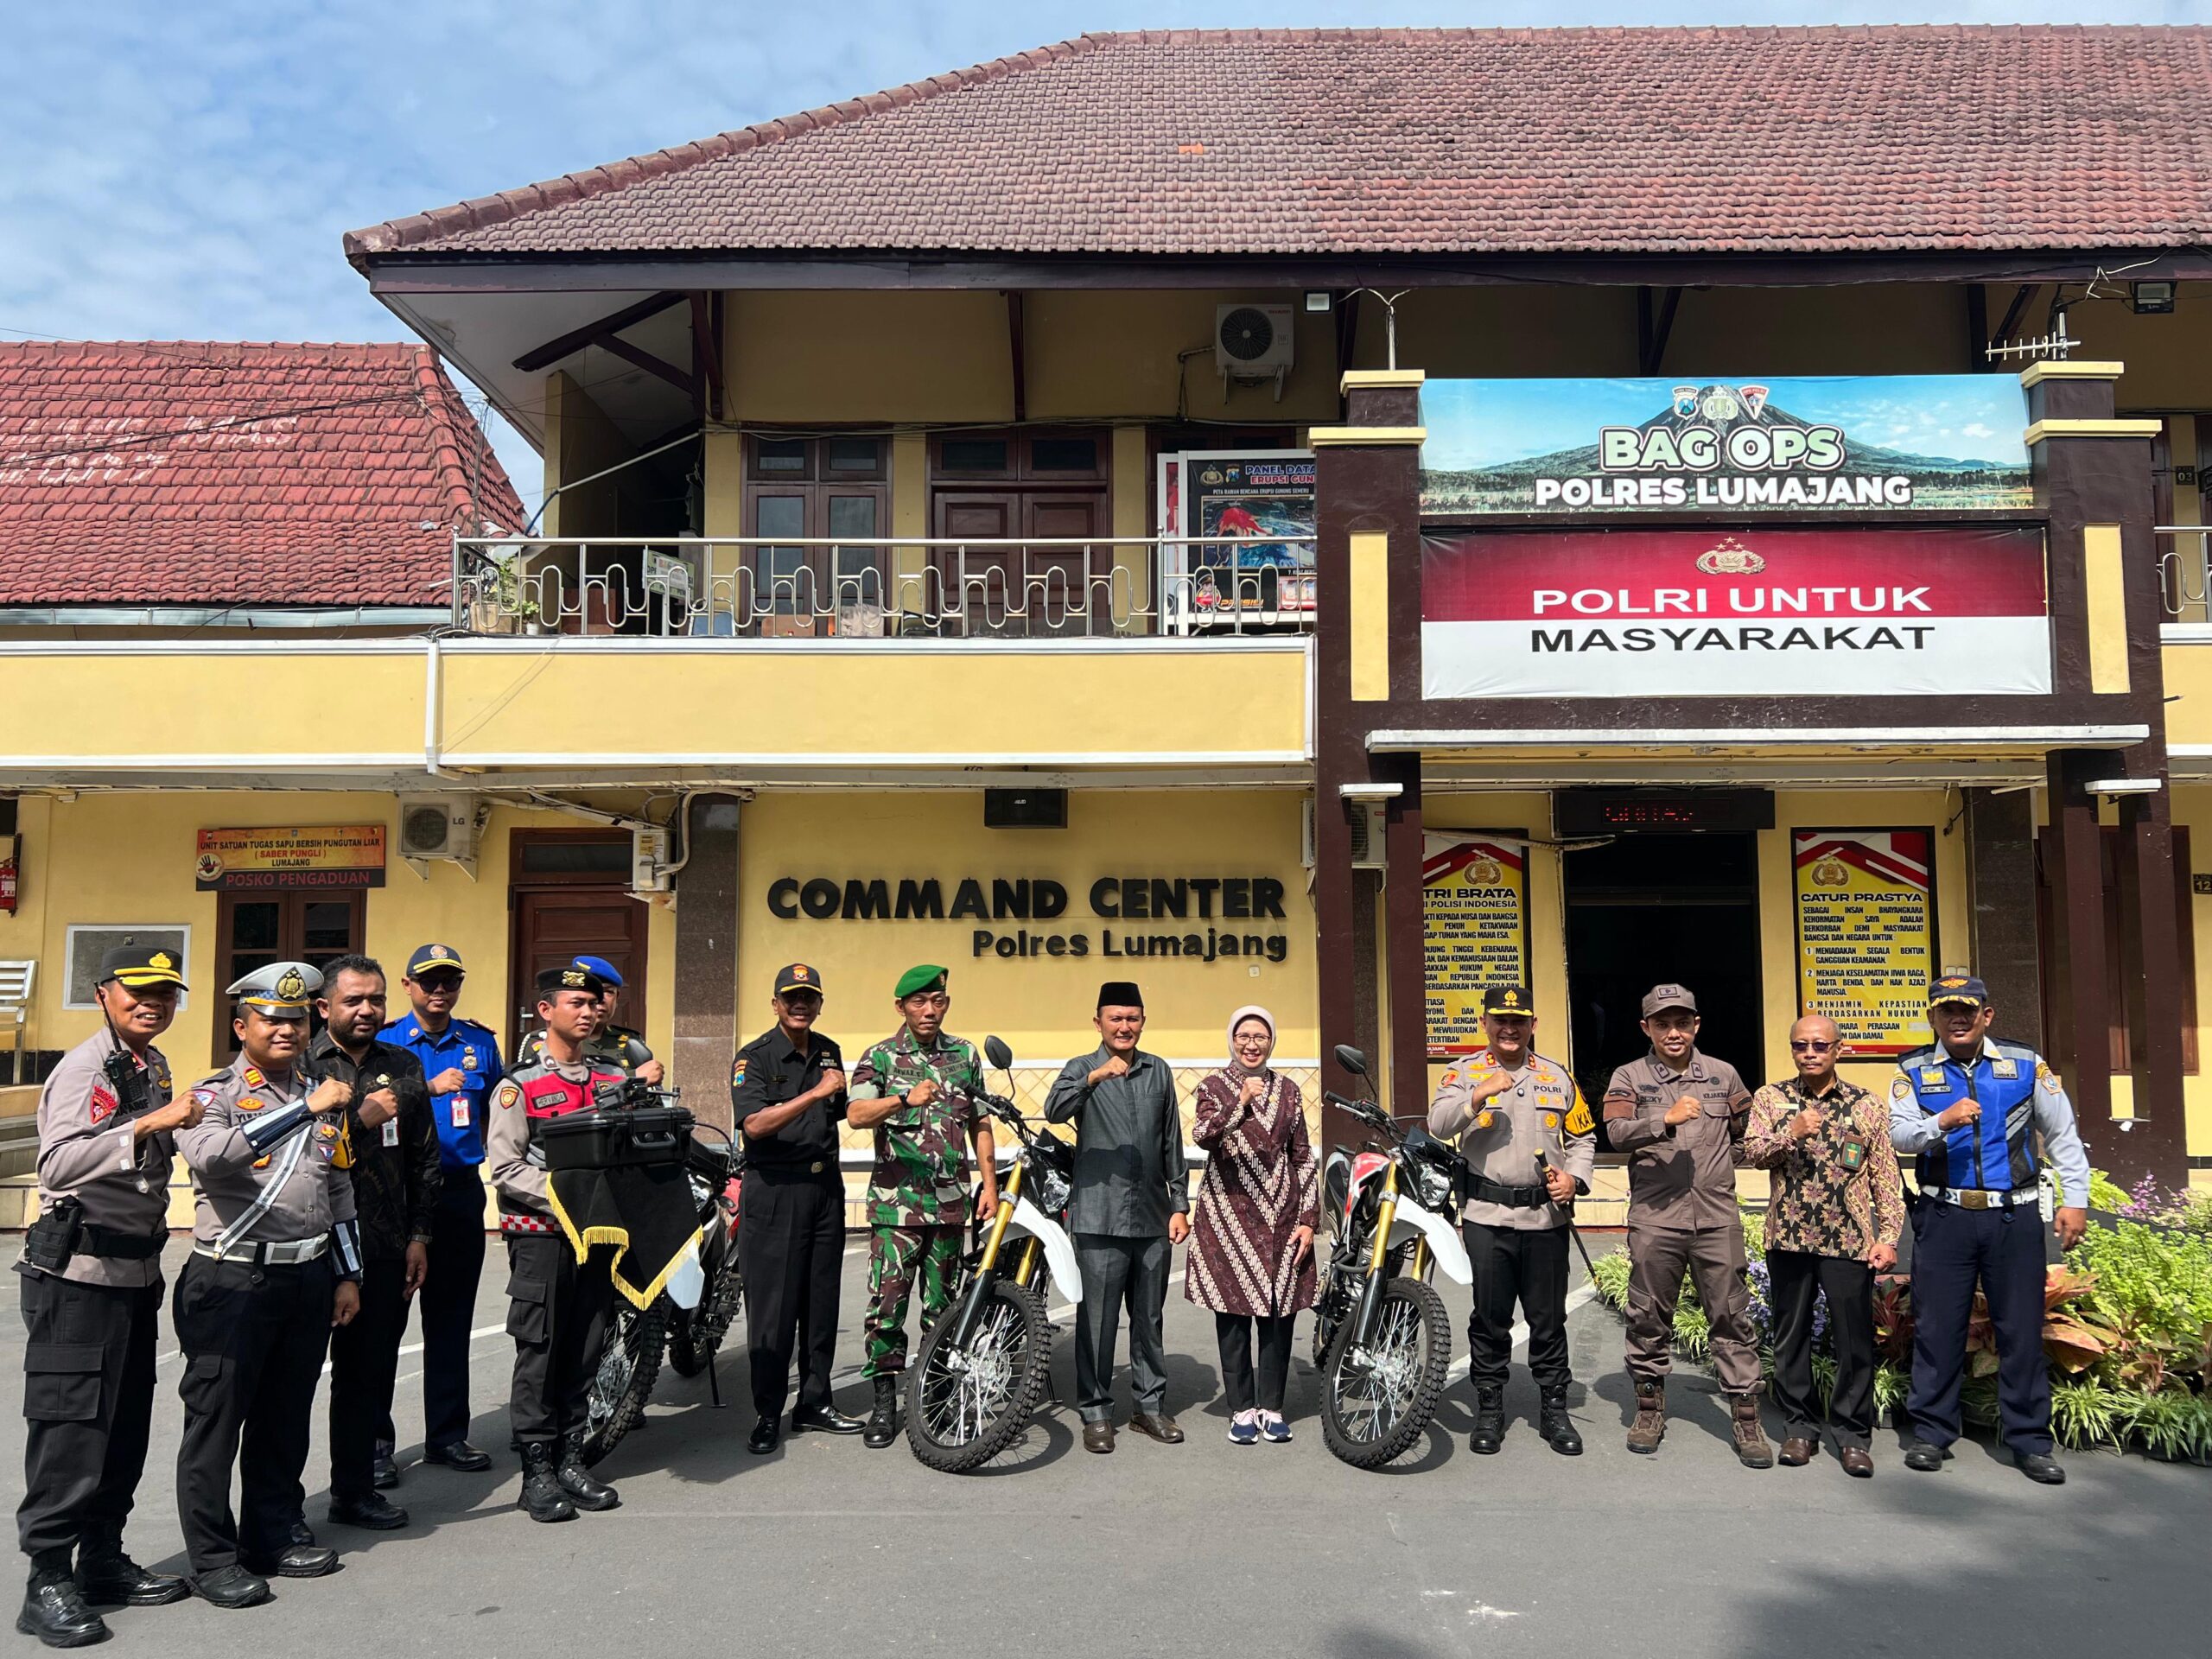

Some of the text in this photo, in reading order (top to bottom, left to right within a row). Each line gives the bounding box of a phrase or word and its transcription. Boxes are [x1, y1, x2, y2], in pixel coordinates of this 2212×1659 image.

[1602, 426, 1843, 469] BAG OPS
[1245, 465, 1284, 474] PANEL
[1250, 475, 1289, 484] ERUPSI
[1536, 477, 1911, 505] POLRES LUMAJANG
[1532, 588, 1932, 614] POLRI UNTUK
[1531, 626, 1936, 652] MASYARAKAT
[219, 841, 247, 849] SATUAN
[296, 839, 322, 848] BERSIH
[324, 838, 361, 847] PUNGUTAN
[260, 849, 288, 858] SABER
[272, 858, 310, 867] LUMAJANG
[226, 871, 370, 887] POSKO PENGADUAN
[767, 877, 1287, 919] COMMAND CENTER
[1423, 889, 1516, 899] TRI BRATA
[1801, 893, 1923, 902] CATUR PRASTYA
[973, 927, 1287, 963] Polres Lumajang
[1534, 1084, 1562, 1094] POLRI
